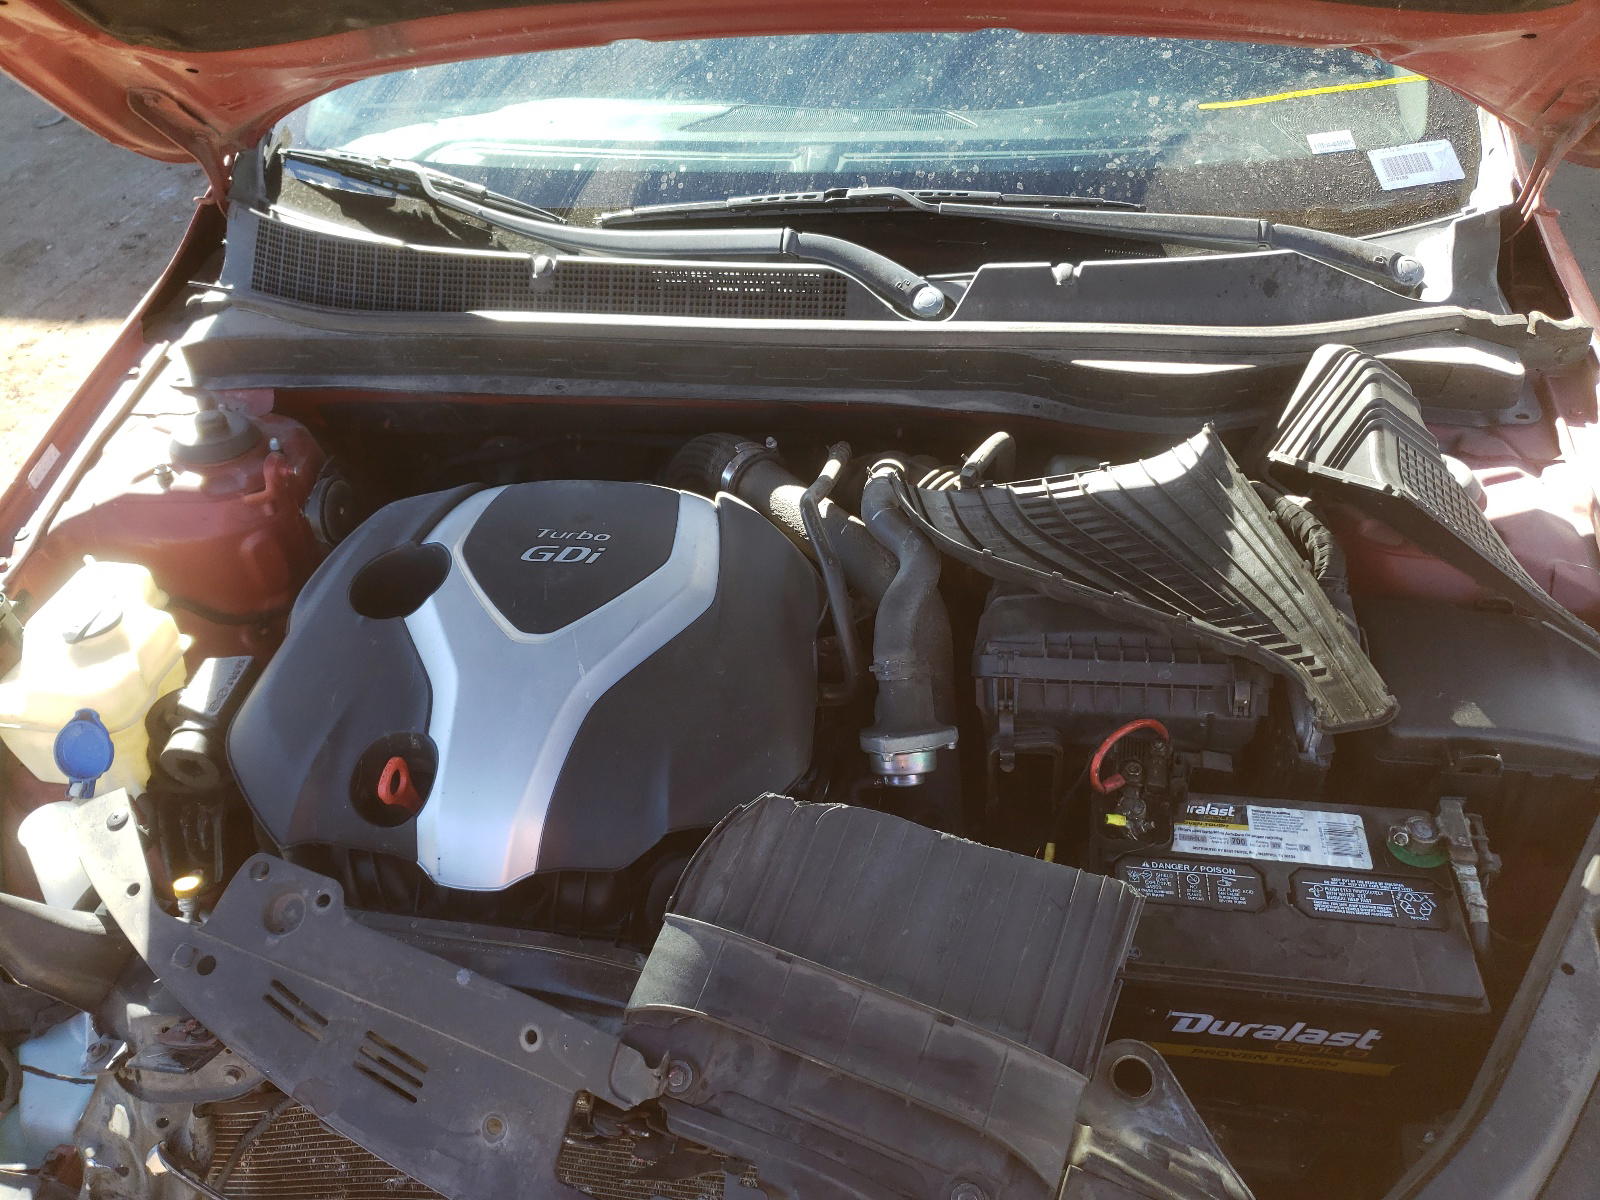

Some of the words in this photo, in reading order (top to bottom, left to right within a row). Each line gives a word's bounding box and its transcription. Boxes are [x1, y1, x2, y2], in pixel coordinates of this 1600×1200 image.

[537, 528, 612, 541] Turbo
[520, 545, 606, 564] GDi
[1187, 803, 1235, 818] ralast
[1231, 837, 1247, 845] 700
[1151, 861, 1190, 872] DANGER
[1200, 865, 1236, 875] POISON
[1167, 1010, 1382, 1050] Duralast
[1191, 1047, 1269, 1061] PROVEN
